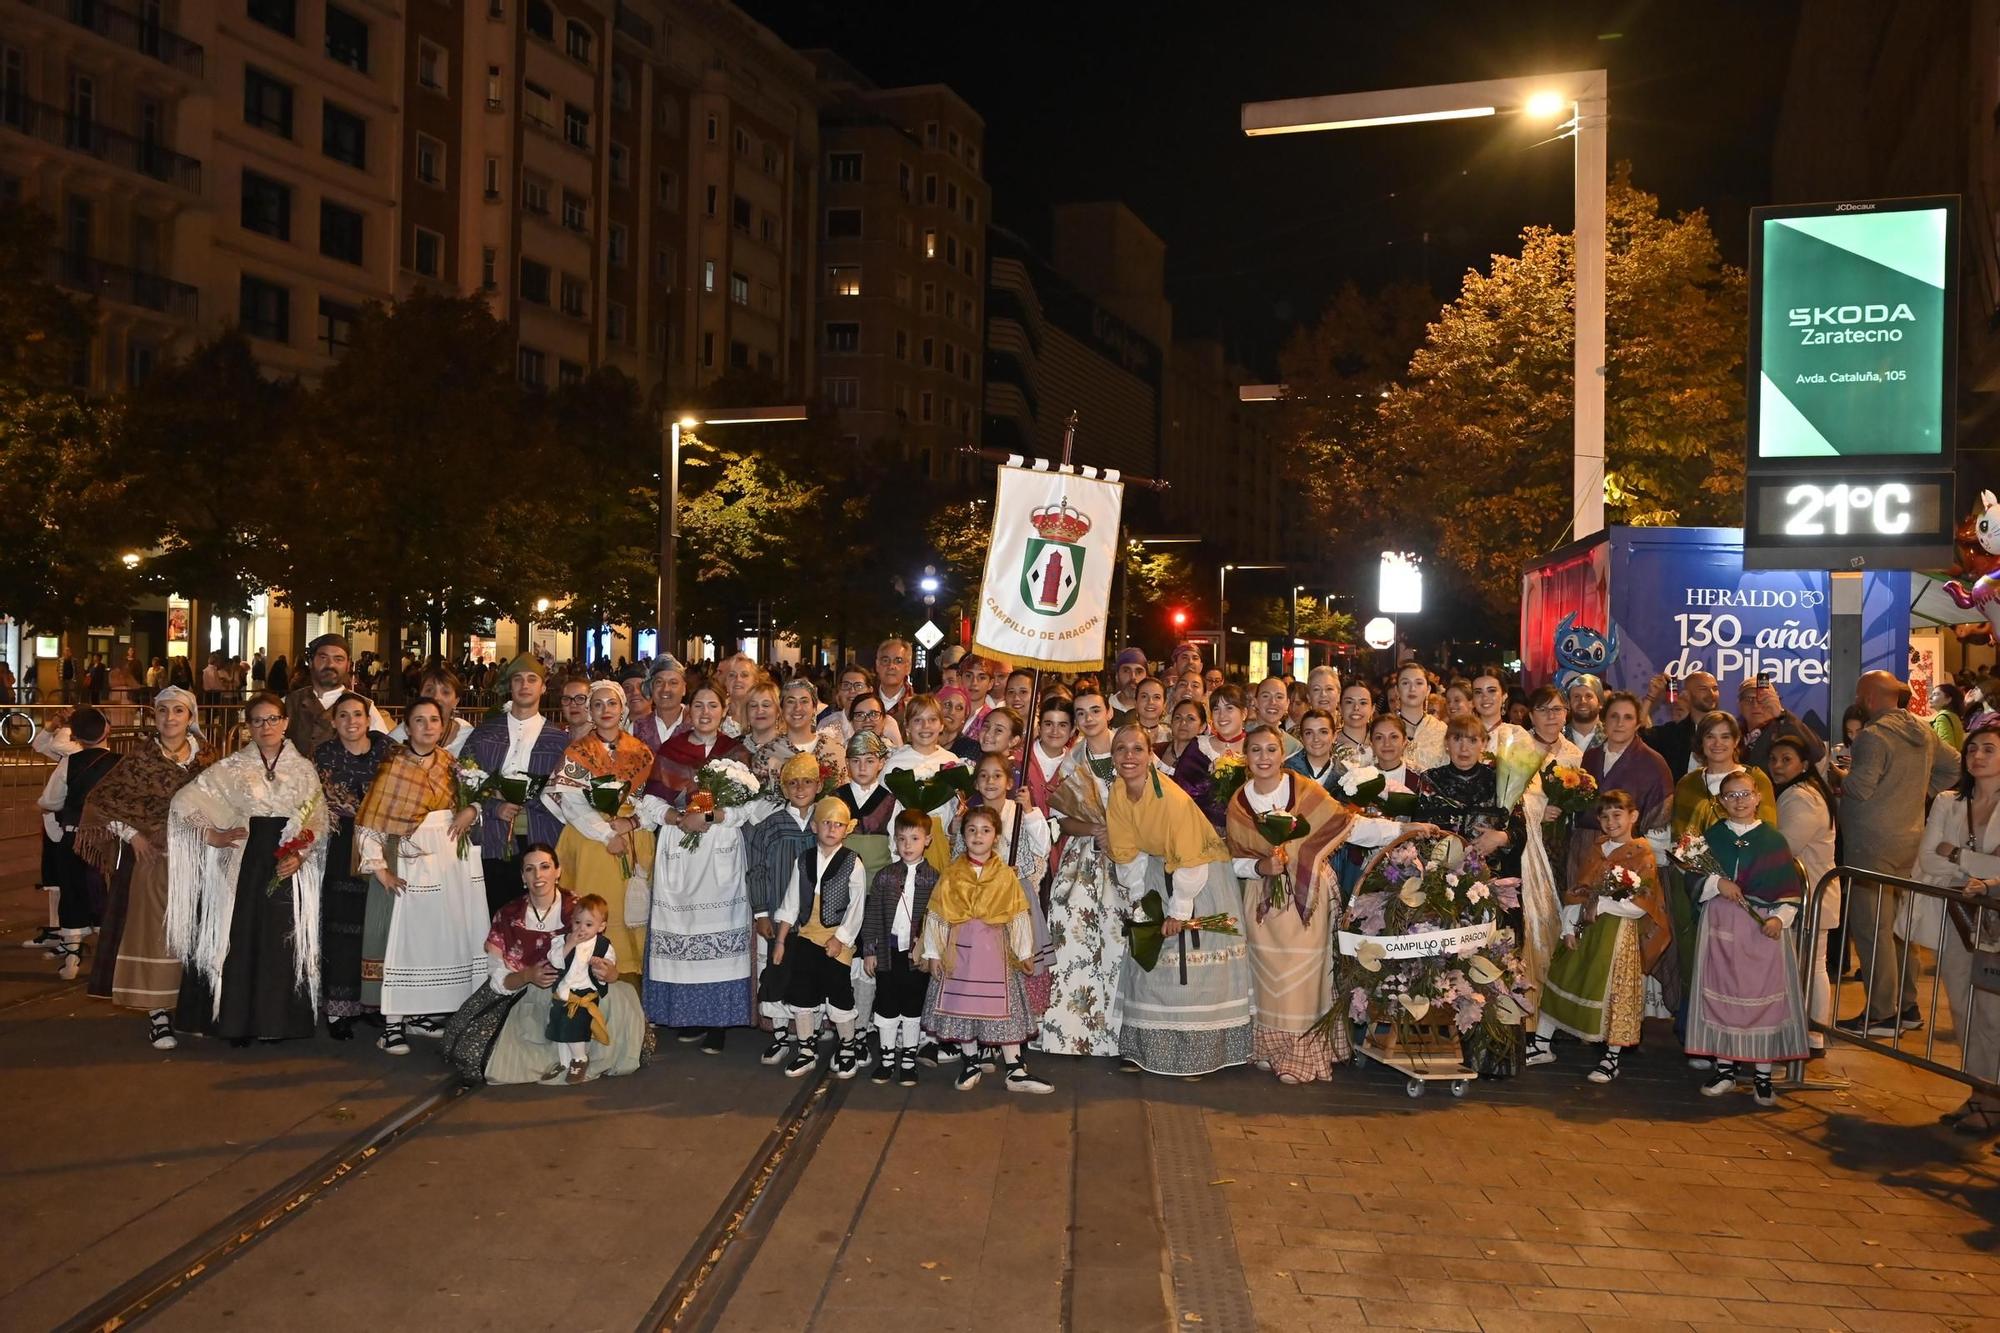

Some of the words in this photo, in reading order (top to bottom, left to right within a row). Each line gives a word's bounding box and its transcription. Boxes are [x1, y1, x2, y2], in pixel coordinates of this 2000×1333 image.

[1836, 203, 1875, 211] JCDecaux
[1801, 328, 1903, 345] Zaratecno
[1796, 374, 1827, 384] Avda.
[1829, 371, 1882, 383] Cataluña,
[1884, 370, 1907, 381] 105
[1686, 588, 1796, 608] HERALDO
[986, 598, 1036, 637] CAMPILLO
[1040, 632, 1055, 640] DE
[1674, 613, 1742, 648] 130
[1664, 648, 1704, 681] de
[1386, 940, 1438, 952] CAMPILLO
[1443, 937, 1456, 947] DE
